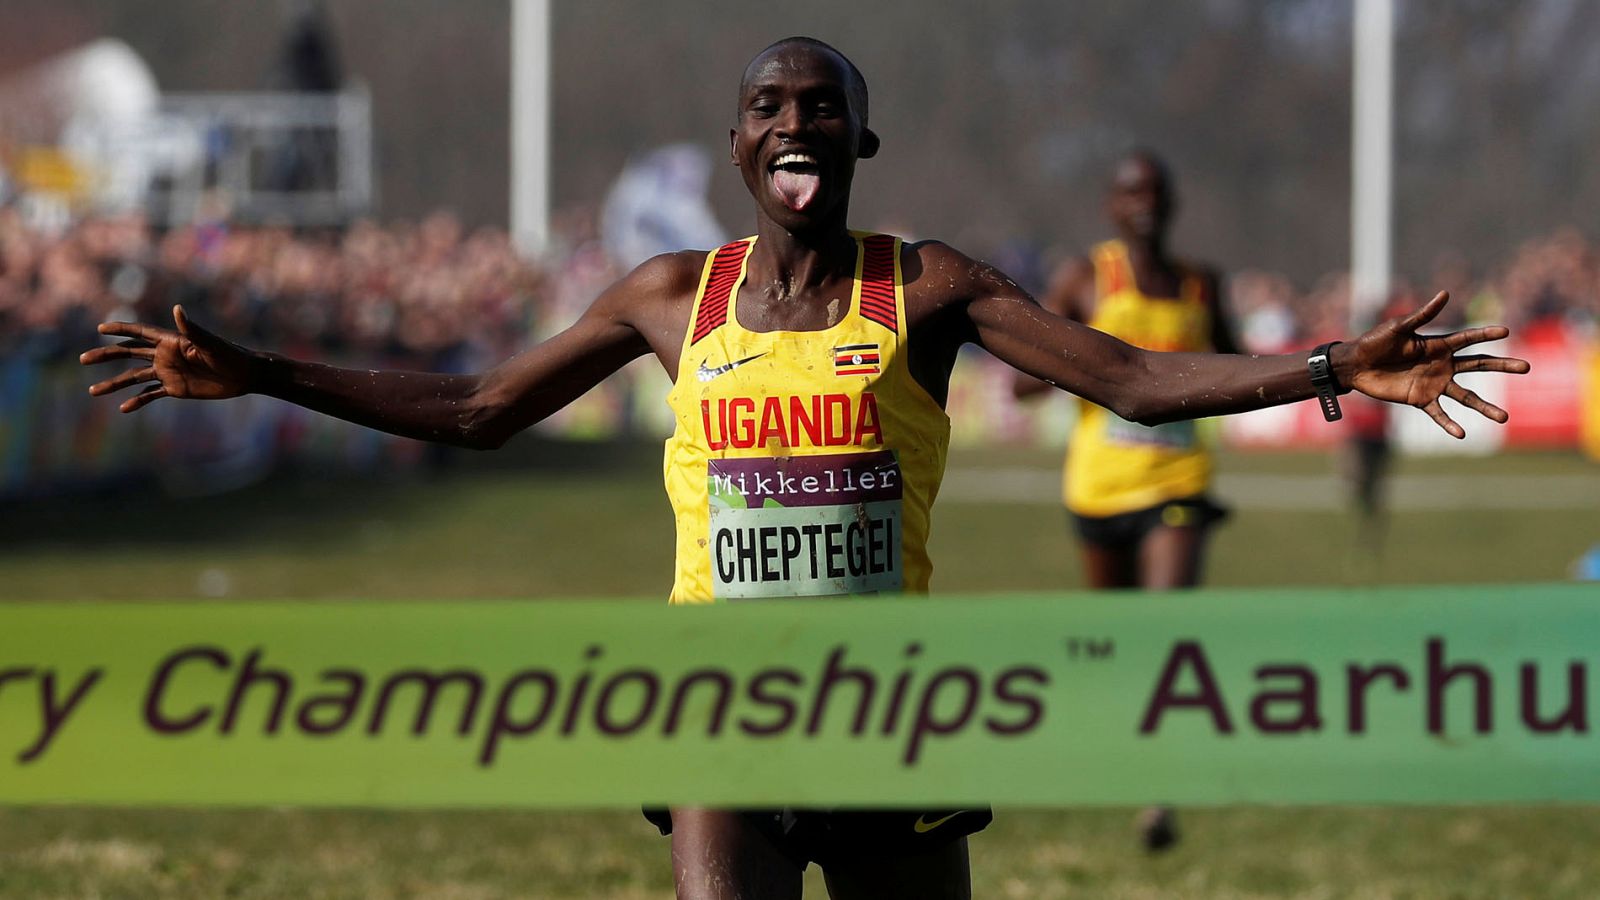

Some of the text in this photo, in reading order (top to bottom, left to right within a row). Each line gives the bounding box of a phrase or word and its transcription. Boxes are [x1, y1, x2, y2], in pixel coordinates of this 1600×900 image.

[701, 392, 884, 451] UGANDA
[712, 468, 898, 497] Mikkeller
[715, 517, 894, 584] CHEPTEGEI
[142, 642, 1050, 767] Championships
[1138, 637, 1588, 736] Aarhu
